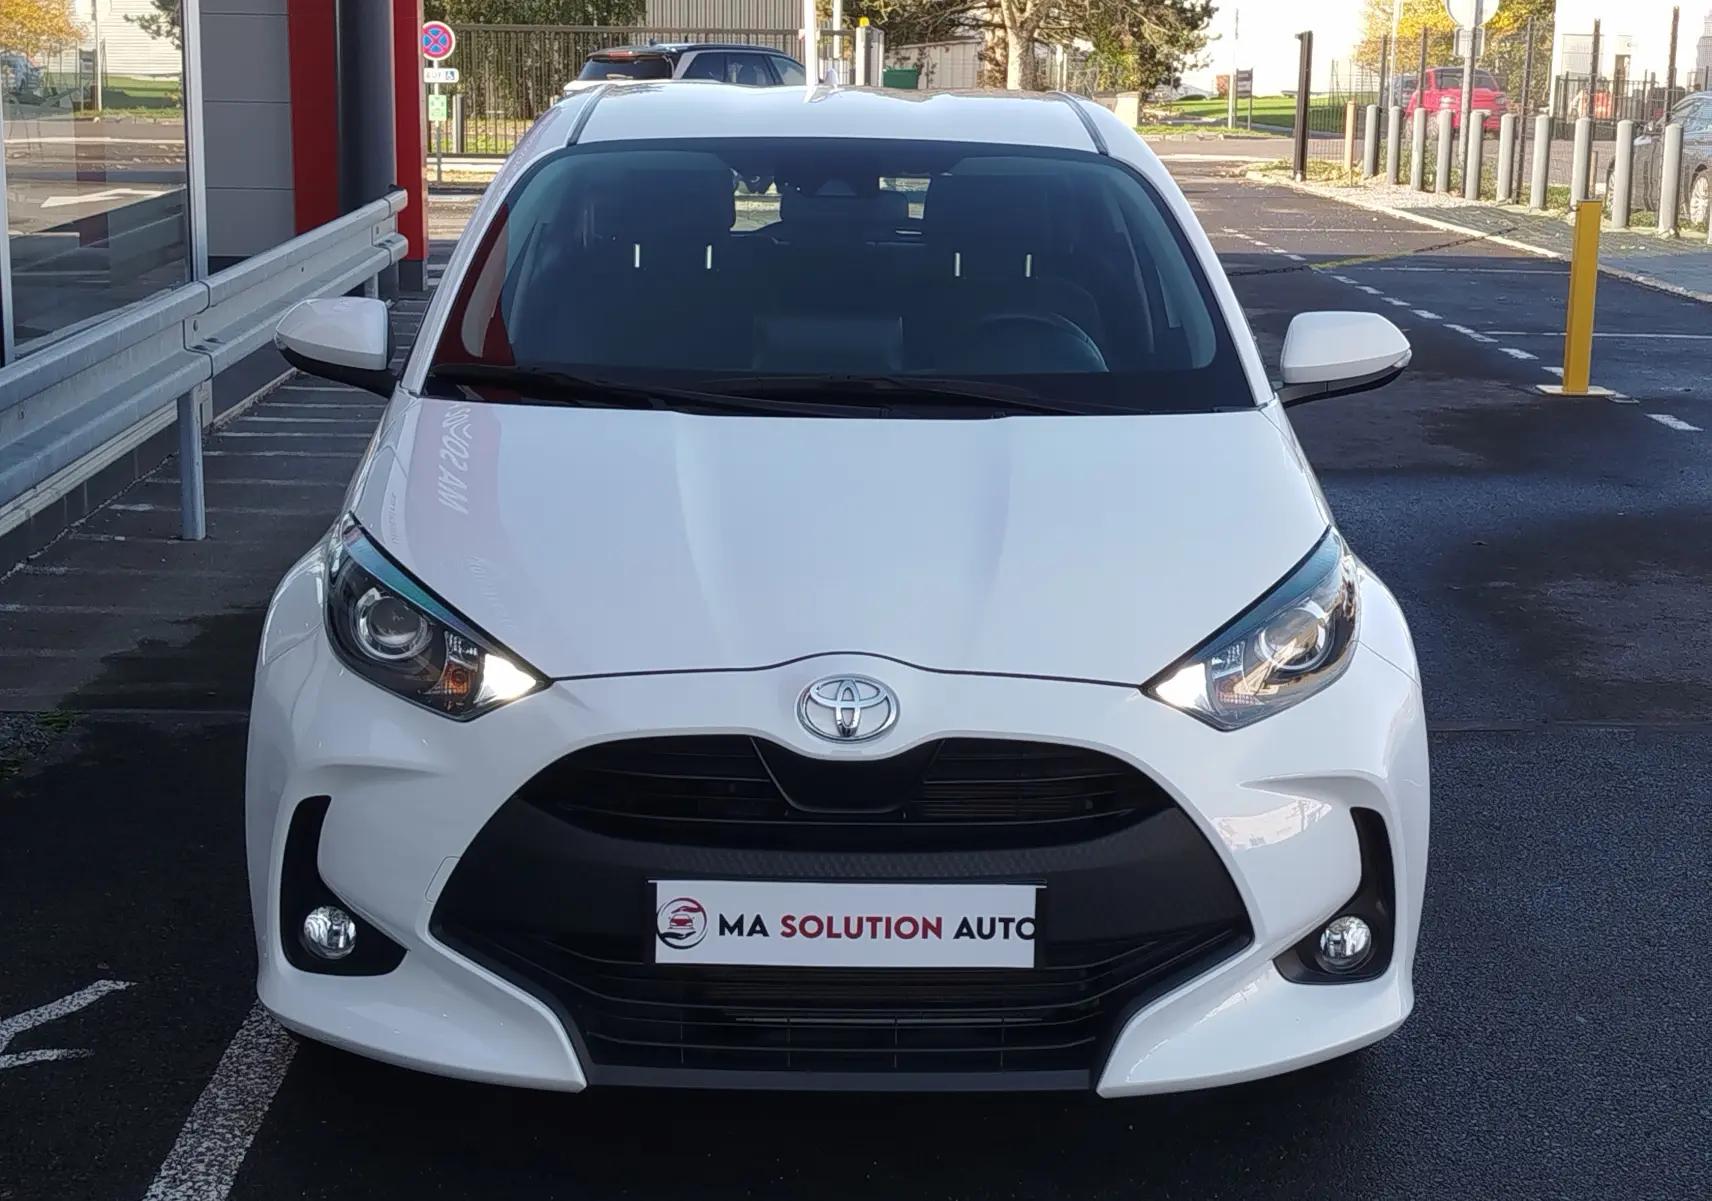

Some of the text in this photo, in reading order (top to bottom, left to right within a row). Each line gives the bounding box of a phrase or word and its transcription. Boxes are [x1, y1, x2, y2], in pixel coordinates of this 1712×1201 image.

[718, 913, 1036, 940] MA SOLUTION AUTO
